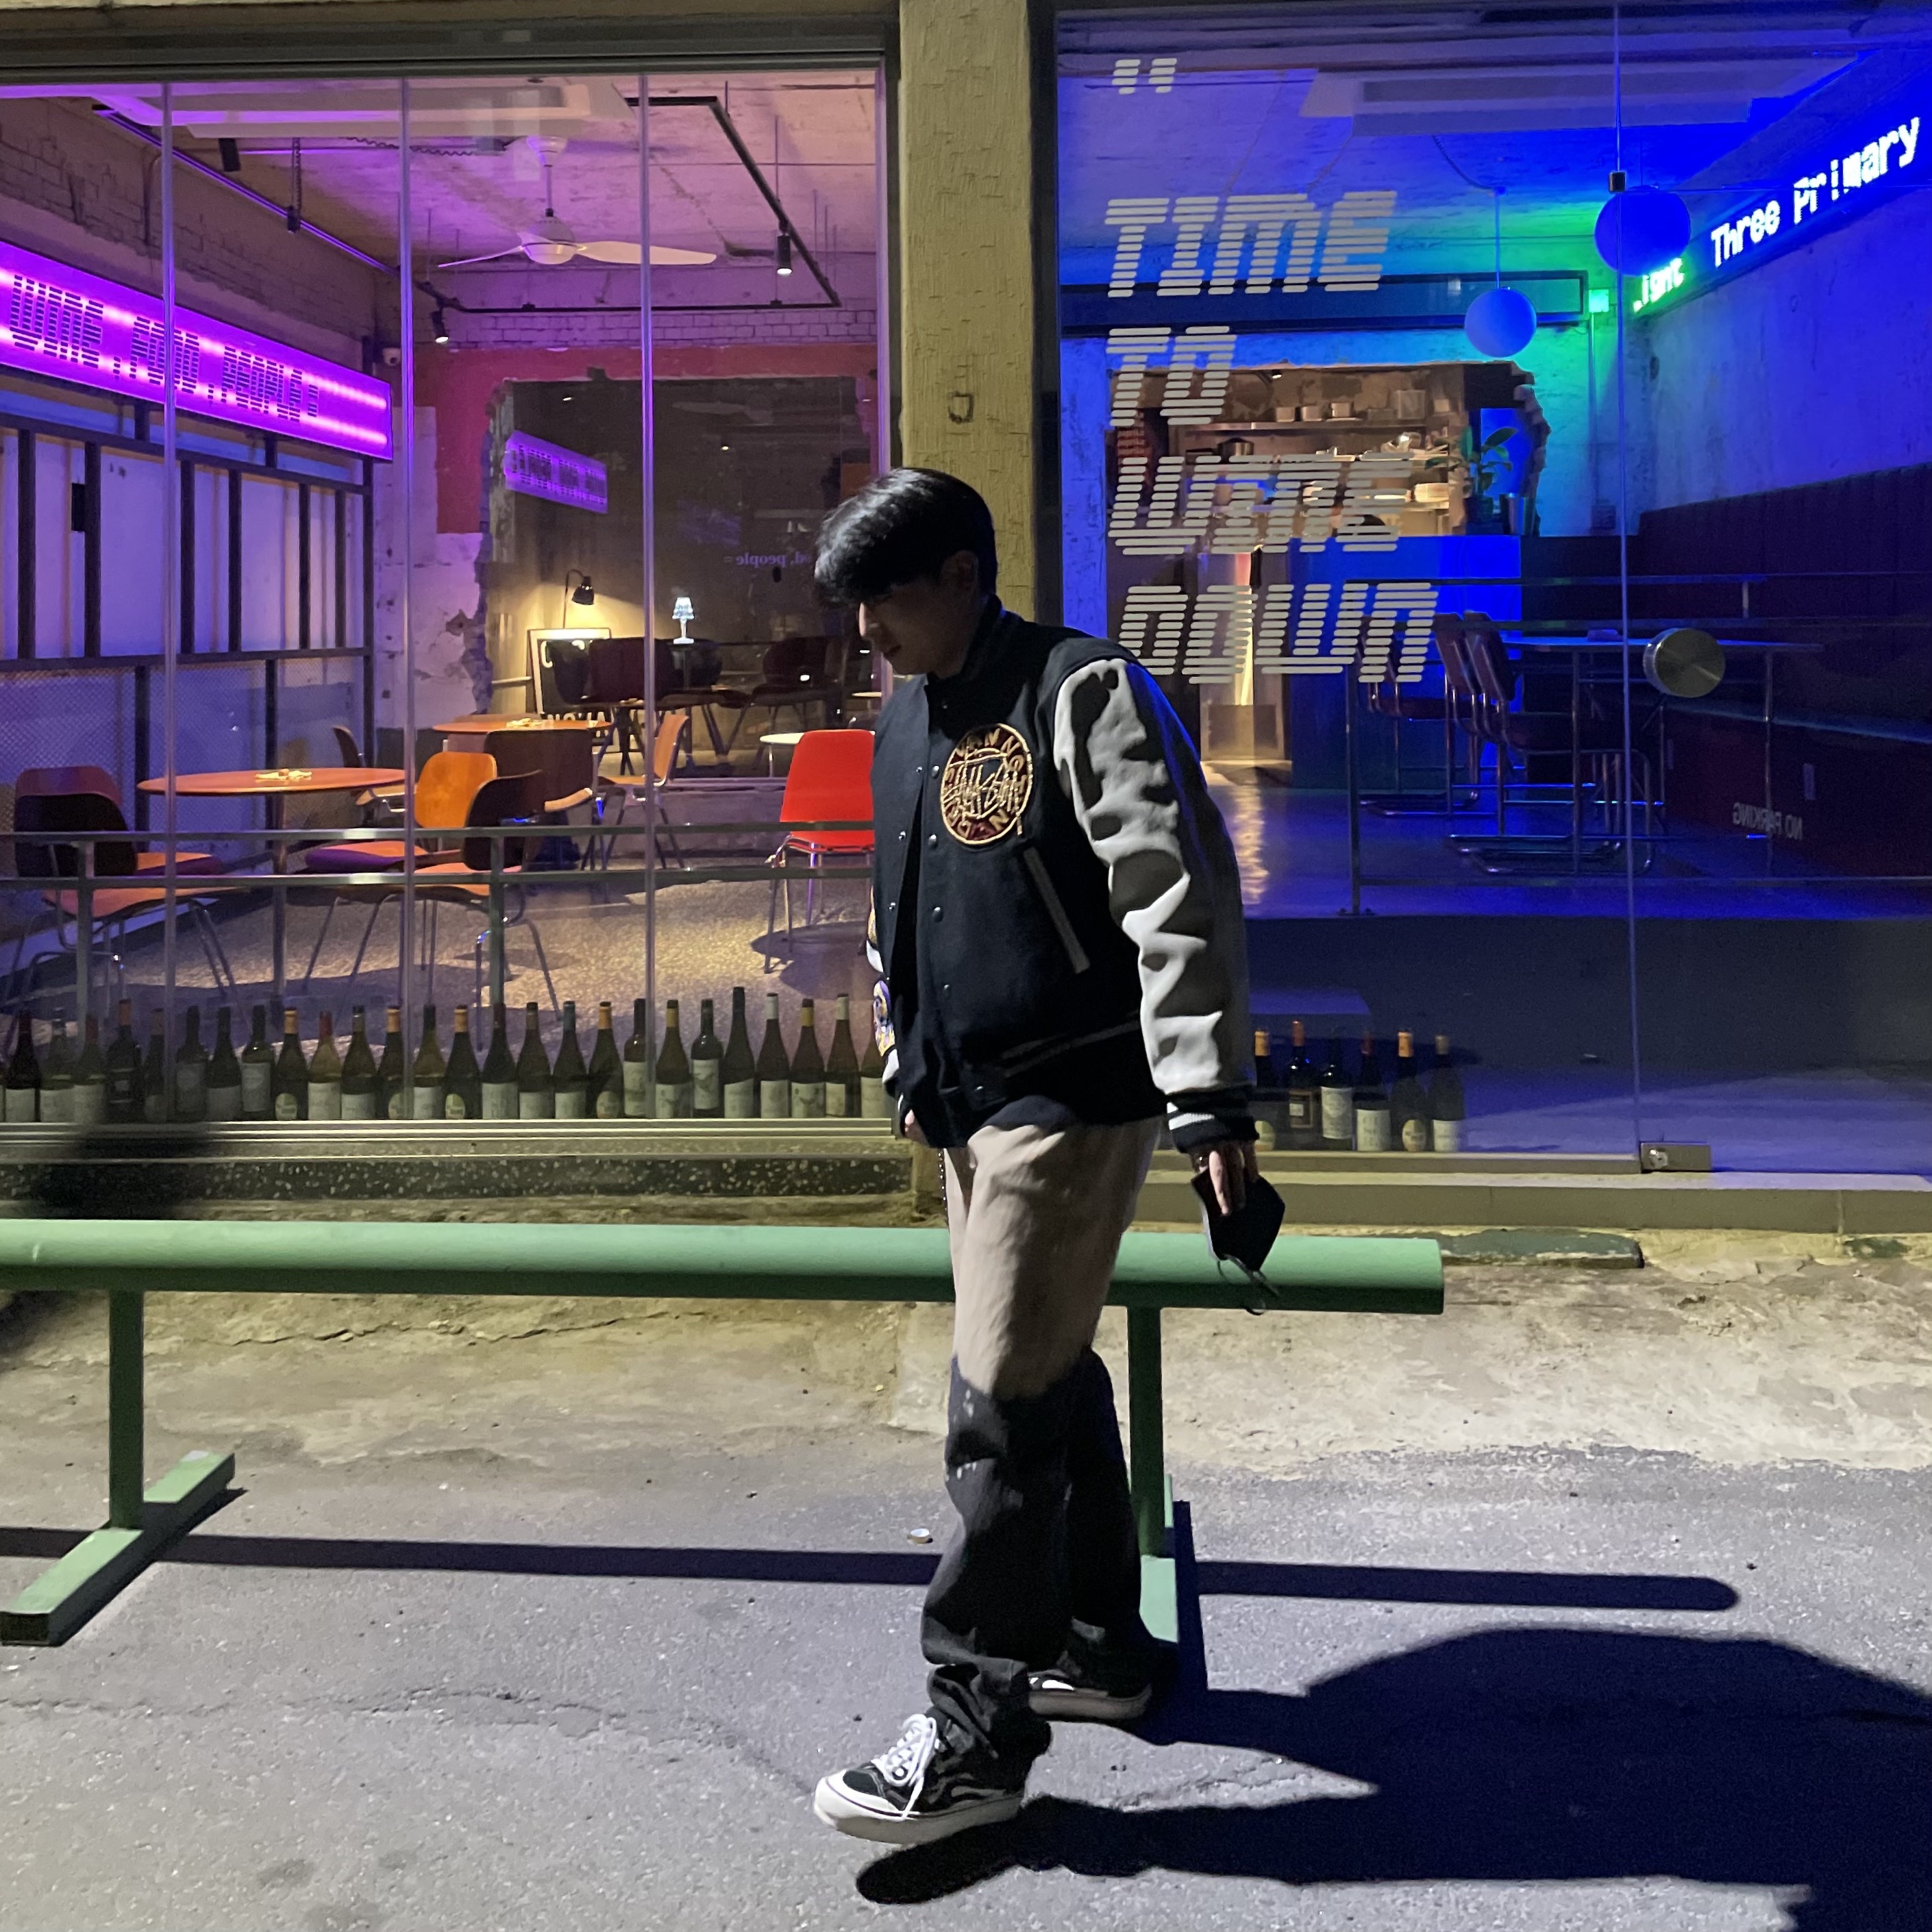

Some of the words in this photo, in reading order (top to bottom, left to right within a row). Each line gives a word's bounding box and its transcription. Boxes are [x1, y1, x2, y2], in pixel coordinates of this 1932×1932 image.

[1104, 190, 1397, 297] TIME
[1633, 258, 1685, 313] ight
[1711, 199, 1781, 268] Three
[1793, 116, 1920, 225] Primary
[1106, 326, 1237, 426] TO
[1108, 452, 1415, 556] WINE
[1119, 583, 1438, 684] DOWN
